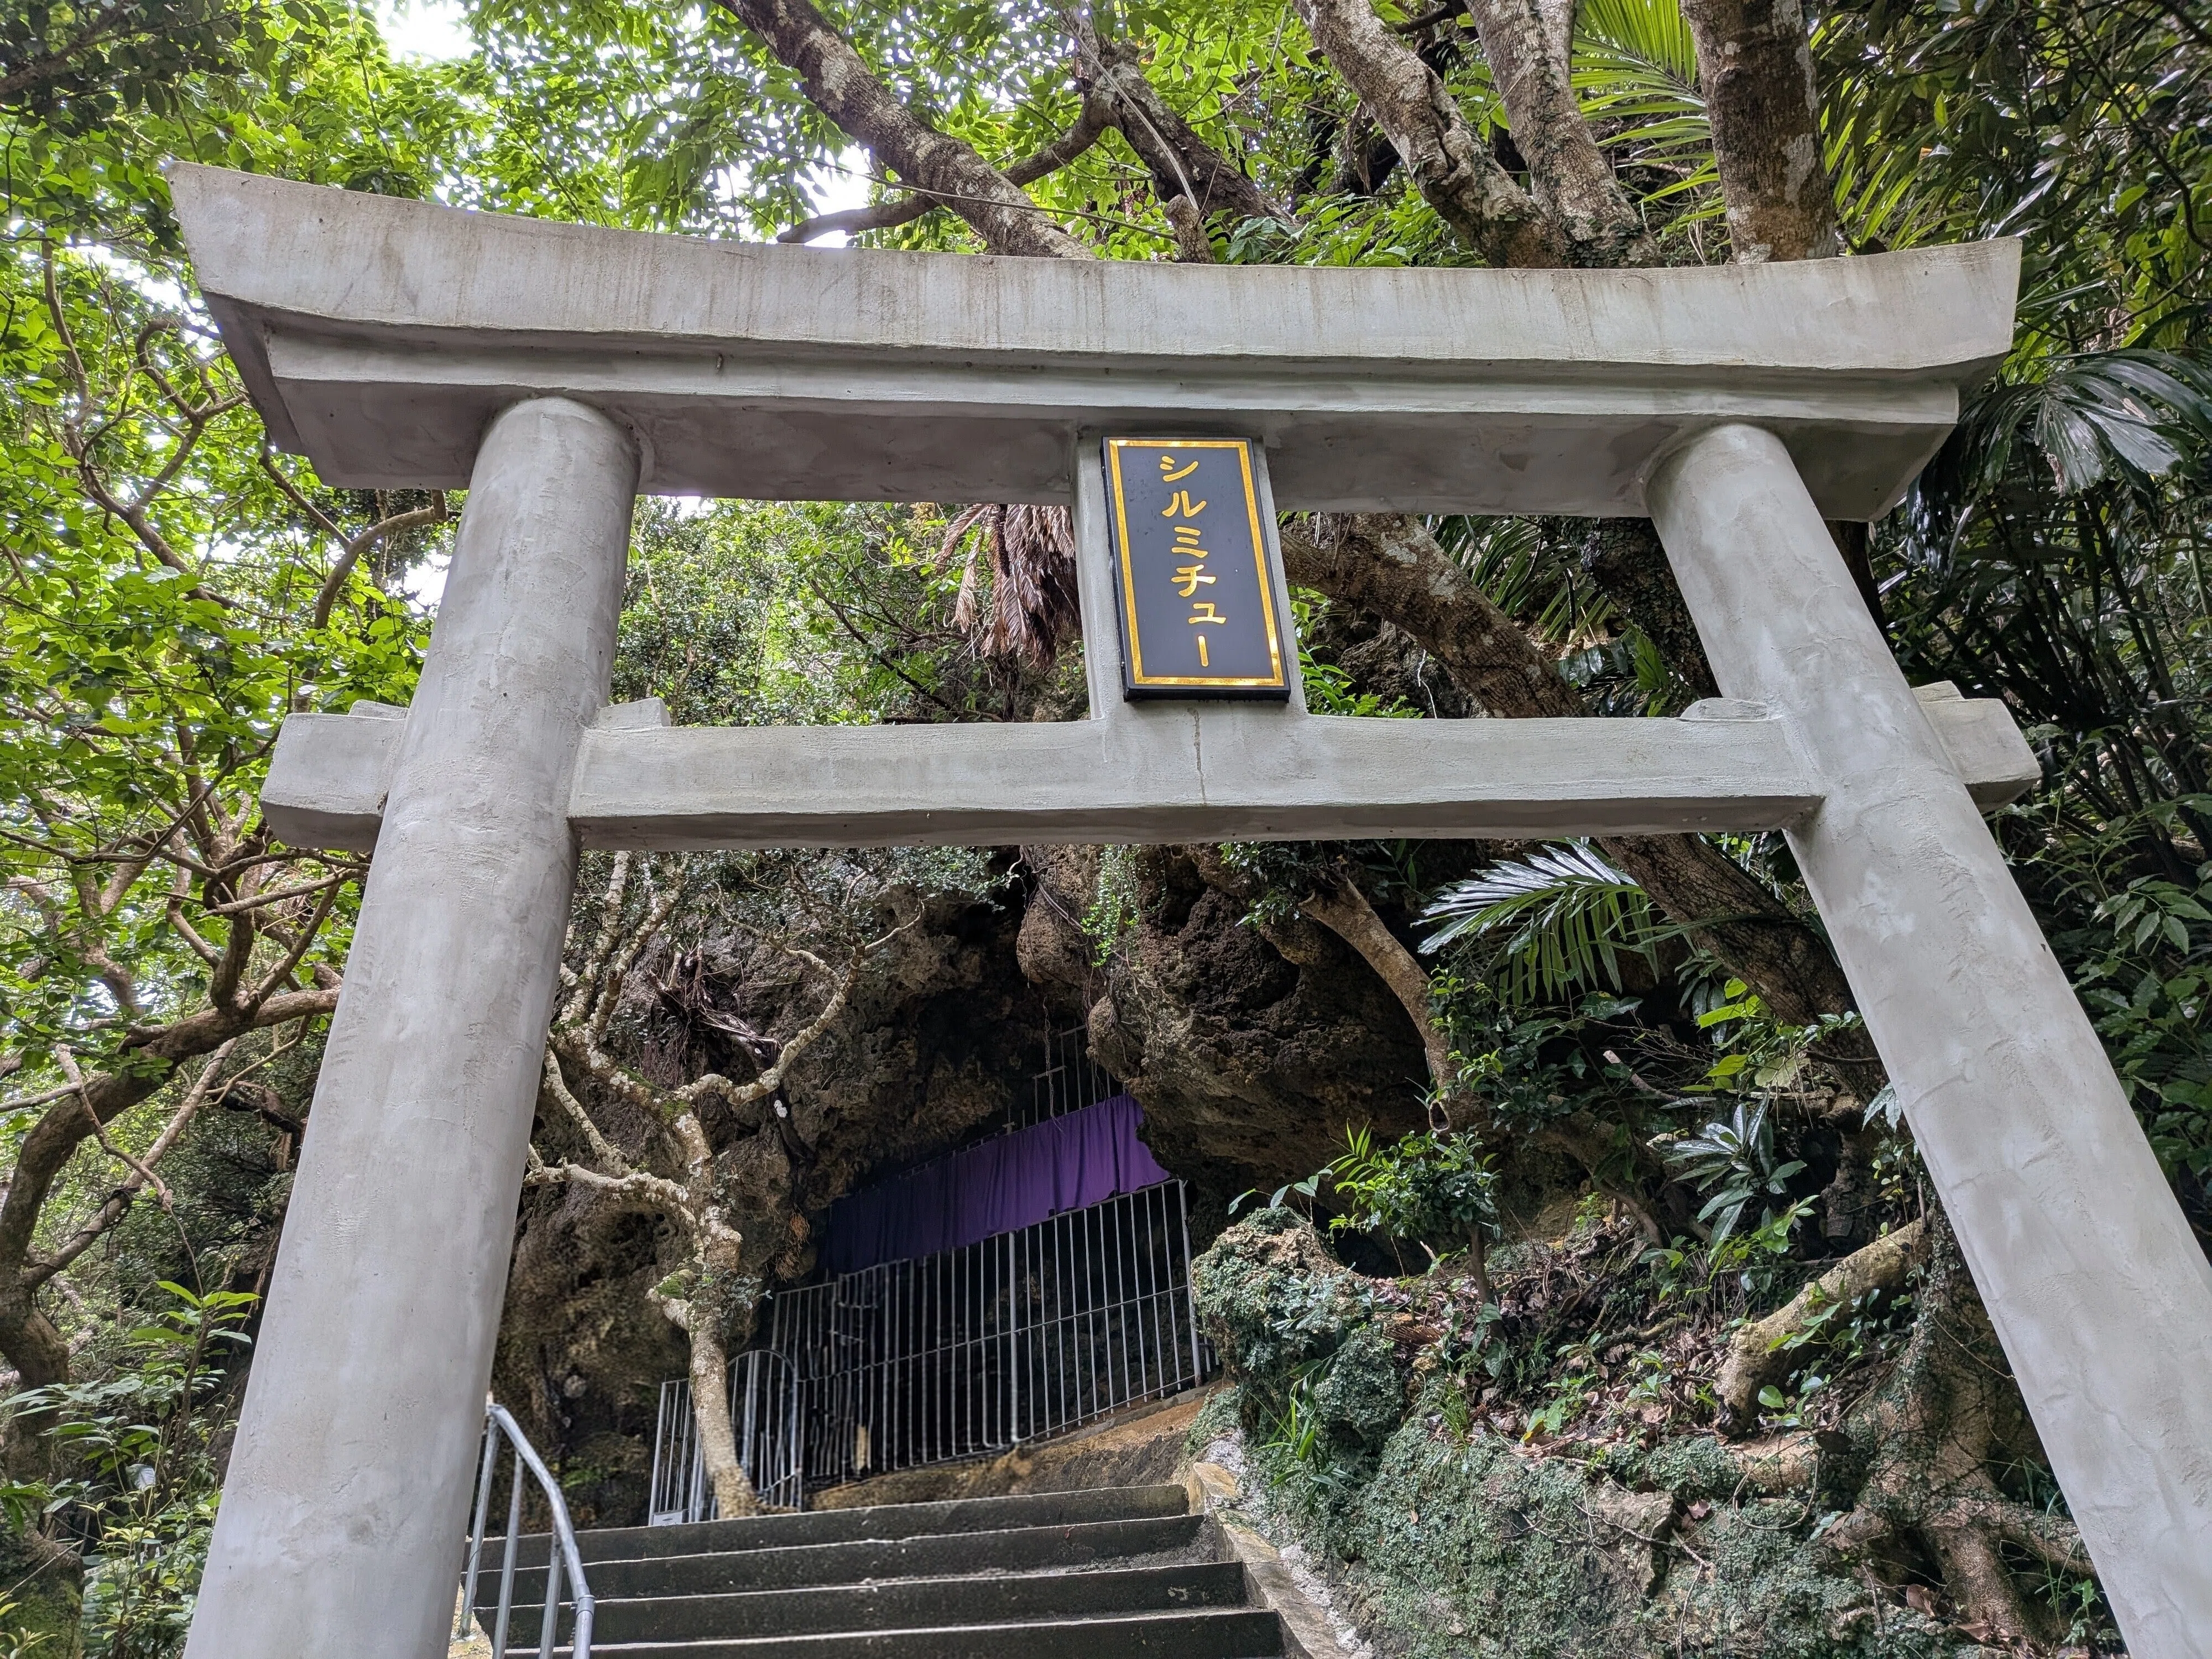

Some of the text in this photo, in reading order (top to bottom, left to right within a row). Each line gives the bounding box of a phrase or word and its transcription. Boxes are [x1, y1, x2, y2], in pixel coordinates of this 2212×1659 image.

[1159, 455, 1227, 667] シルミチュー
